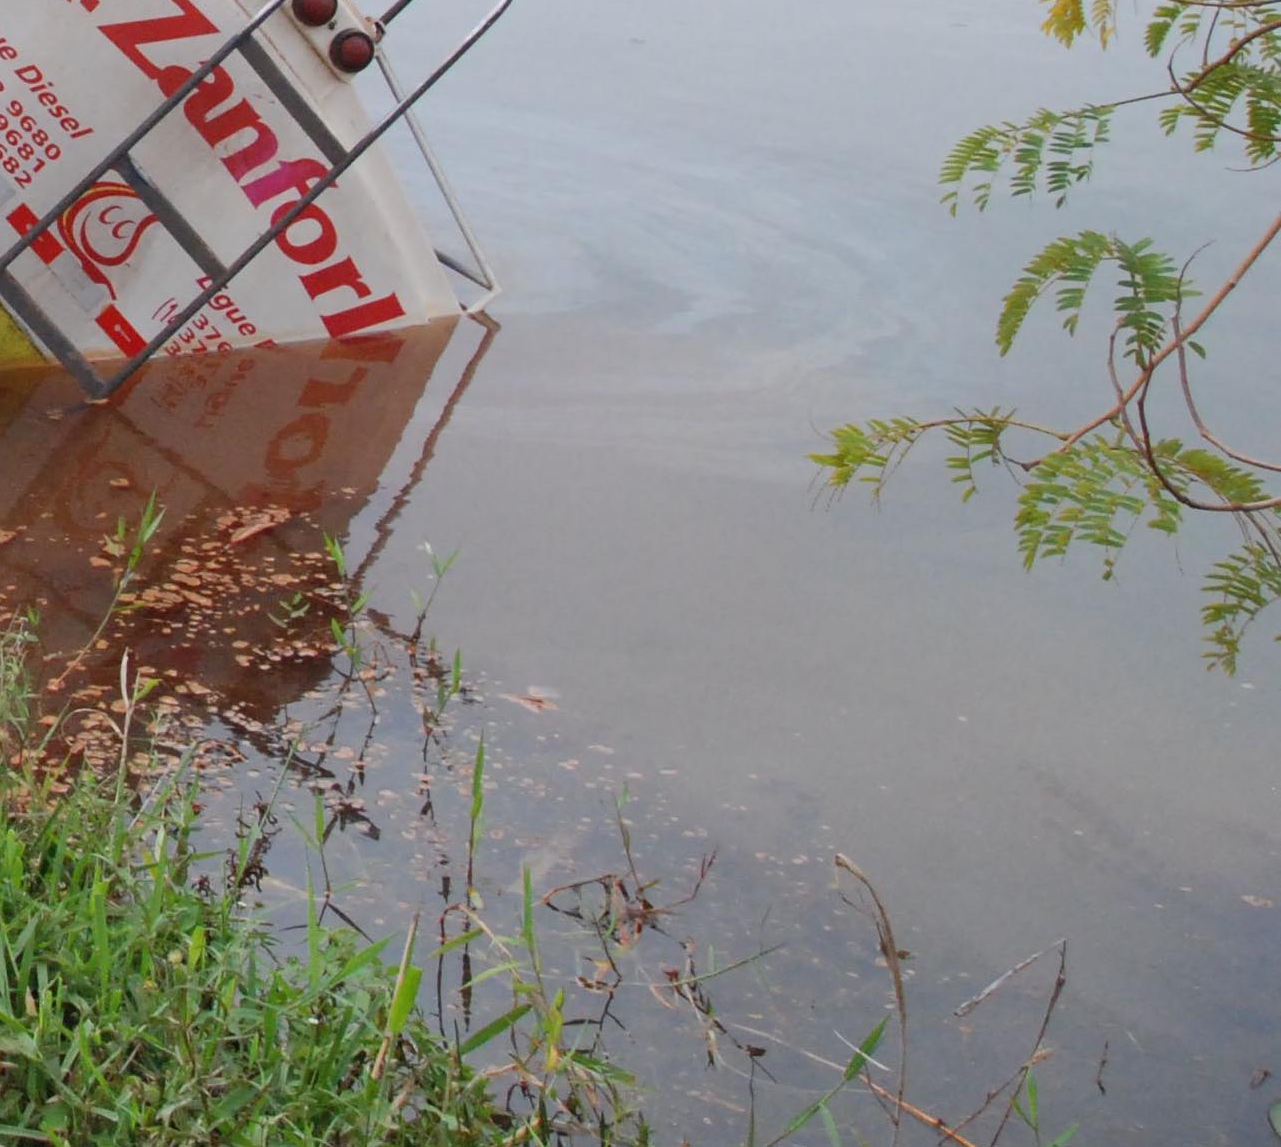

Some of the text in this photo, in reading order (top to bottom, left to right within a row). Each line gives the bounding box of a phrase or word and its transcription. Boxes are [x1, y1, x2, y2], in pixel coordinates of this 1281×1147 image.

[6, 100, 61, 161] 9680
[15, 65, 95, 139] Diesel
[196, 275, 257, 336] Lgue
